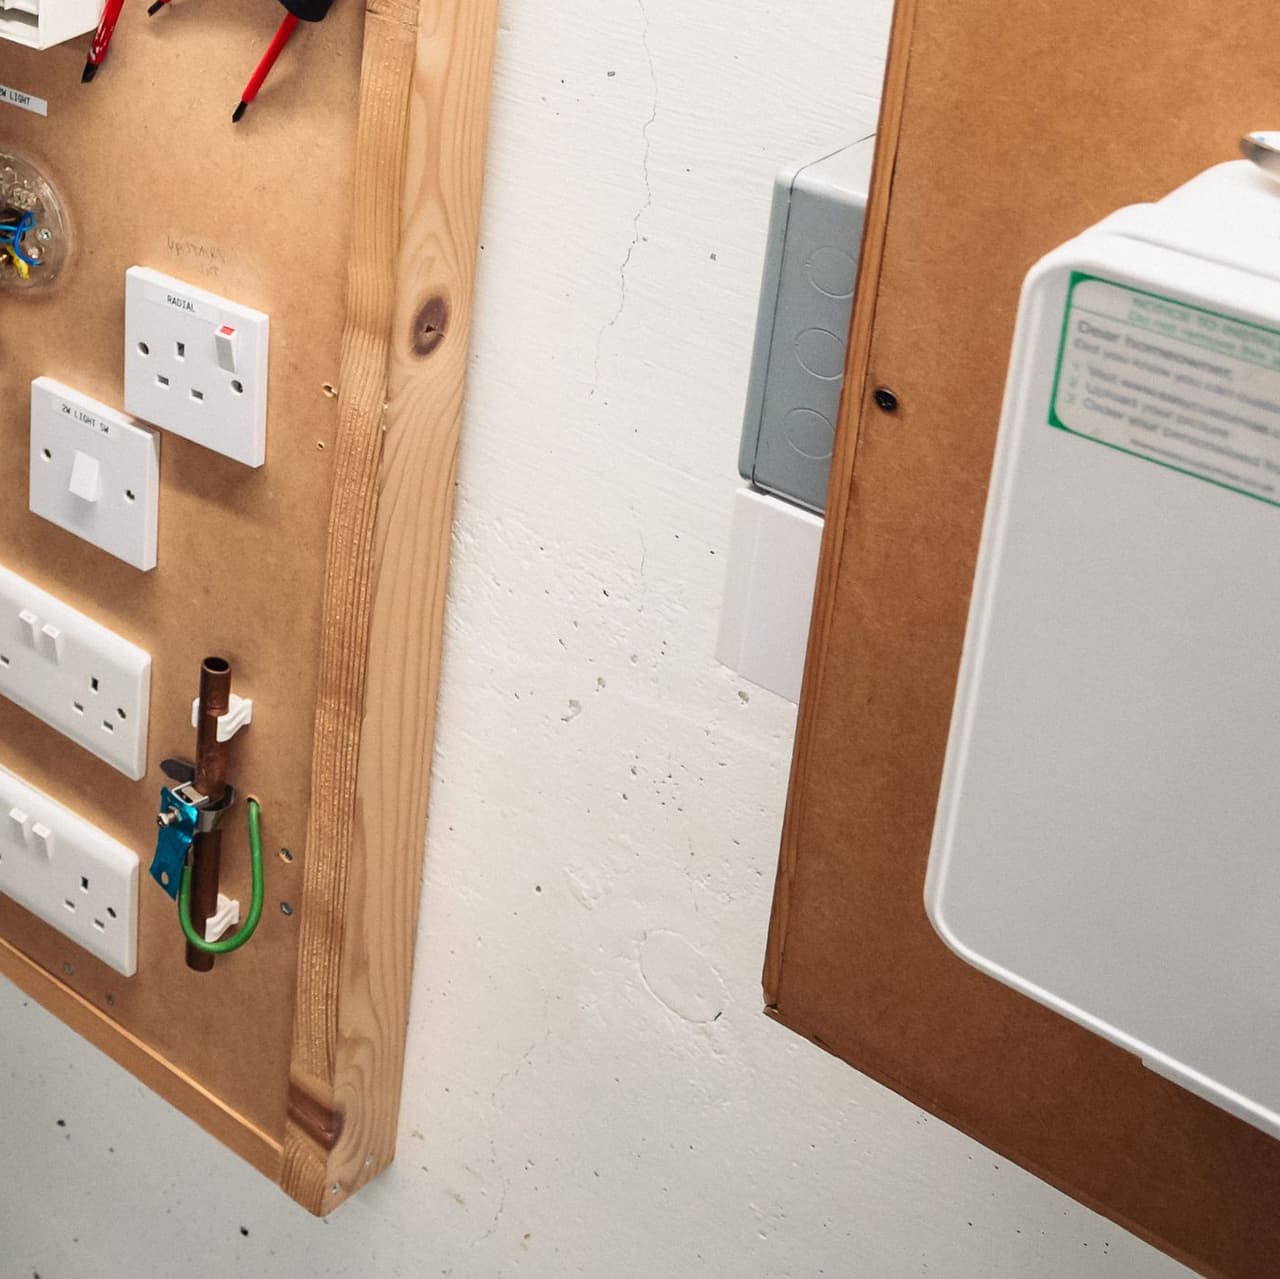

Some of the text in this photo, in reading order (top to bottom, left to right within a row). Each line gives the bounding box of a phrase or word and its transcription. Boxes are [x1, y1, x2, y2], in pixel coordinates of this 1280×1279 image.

[9, 90, 31, 105] LIGHT
[166, 294, 196, 313] RADIAL
[61, 403, 71, 414] 2W
[74, 409, 96, 428] LIGHT
